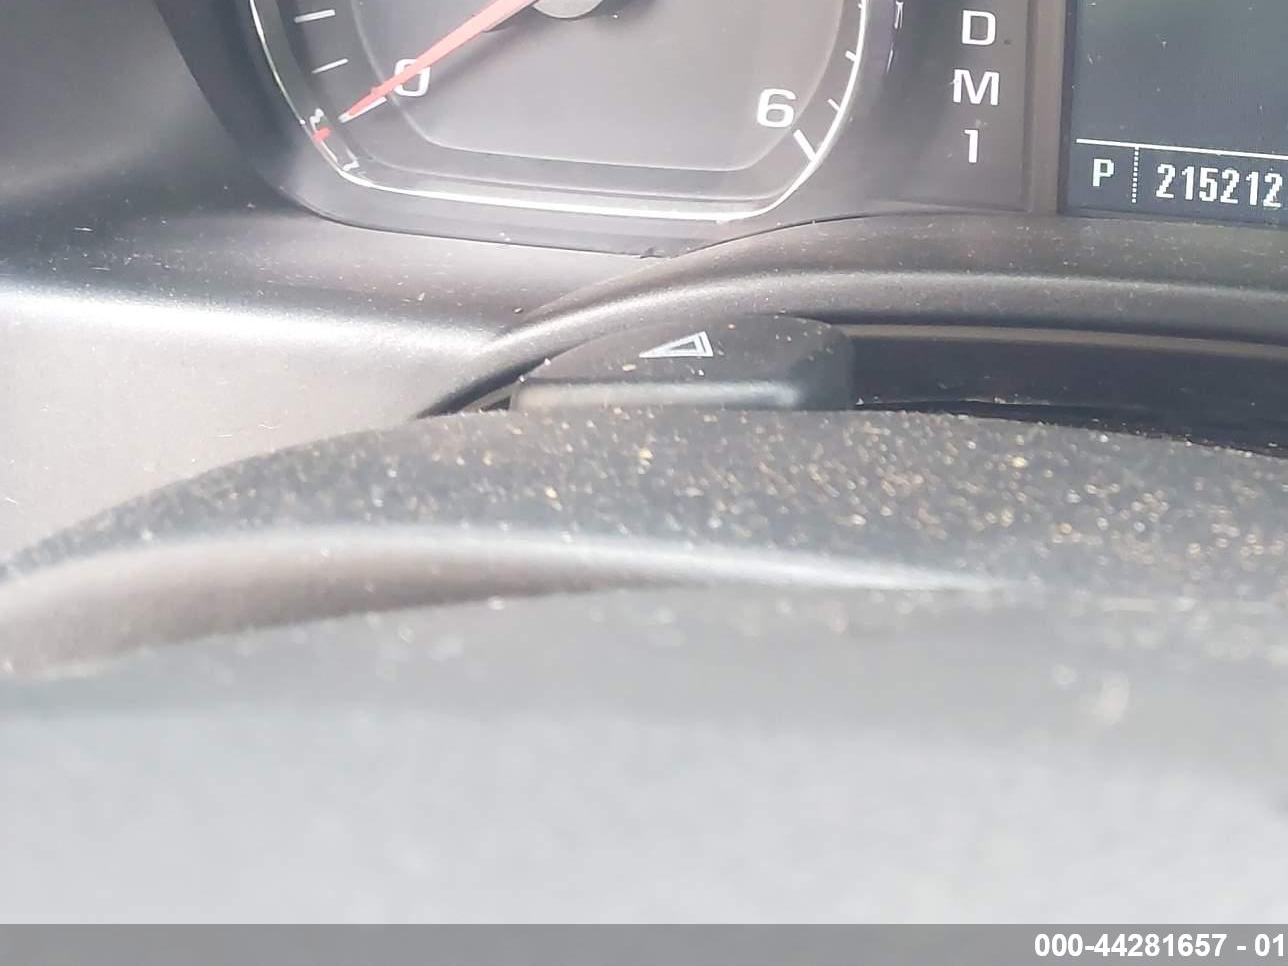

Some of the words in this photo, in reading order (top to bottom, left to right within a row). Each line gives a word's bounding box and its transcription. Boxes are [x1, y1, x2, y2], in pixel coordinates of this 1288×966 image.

[961, 9, 996, 46] D
[394, 58, 431, 97] 0
[952, 69, 1000, 106] M
[756, 88, 796, 128] 6
[1092, 158, 1115, 187] P
[1155, 163, 1283, 208] 215212
